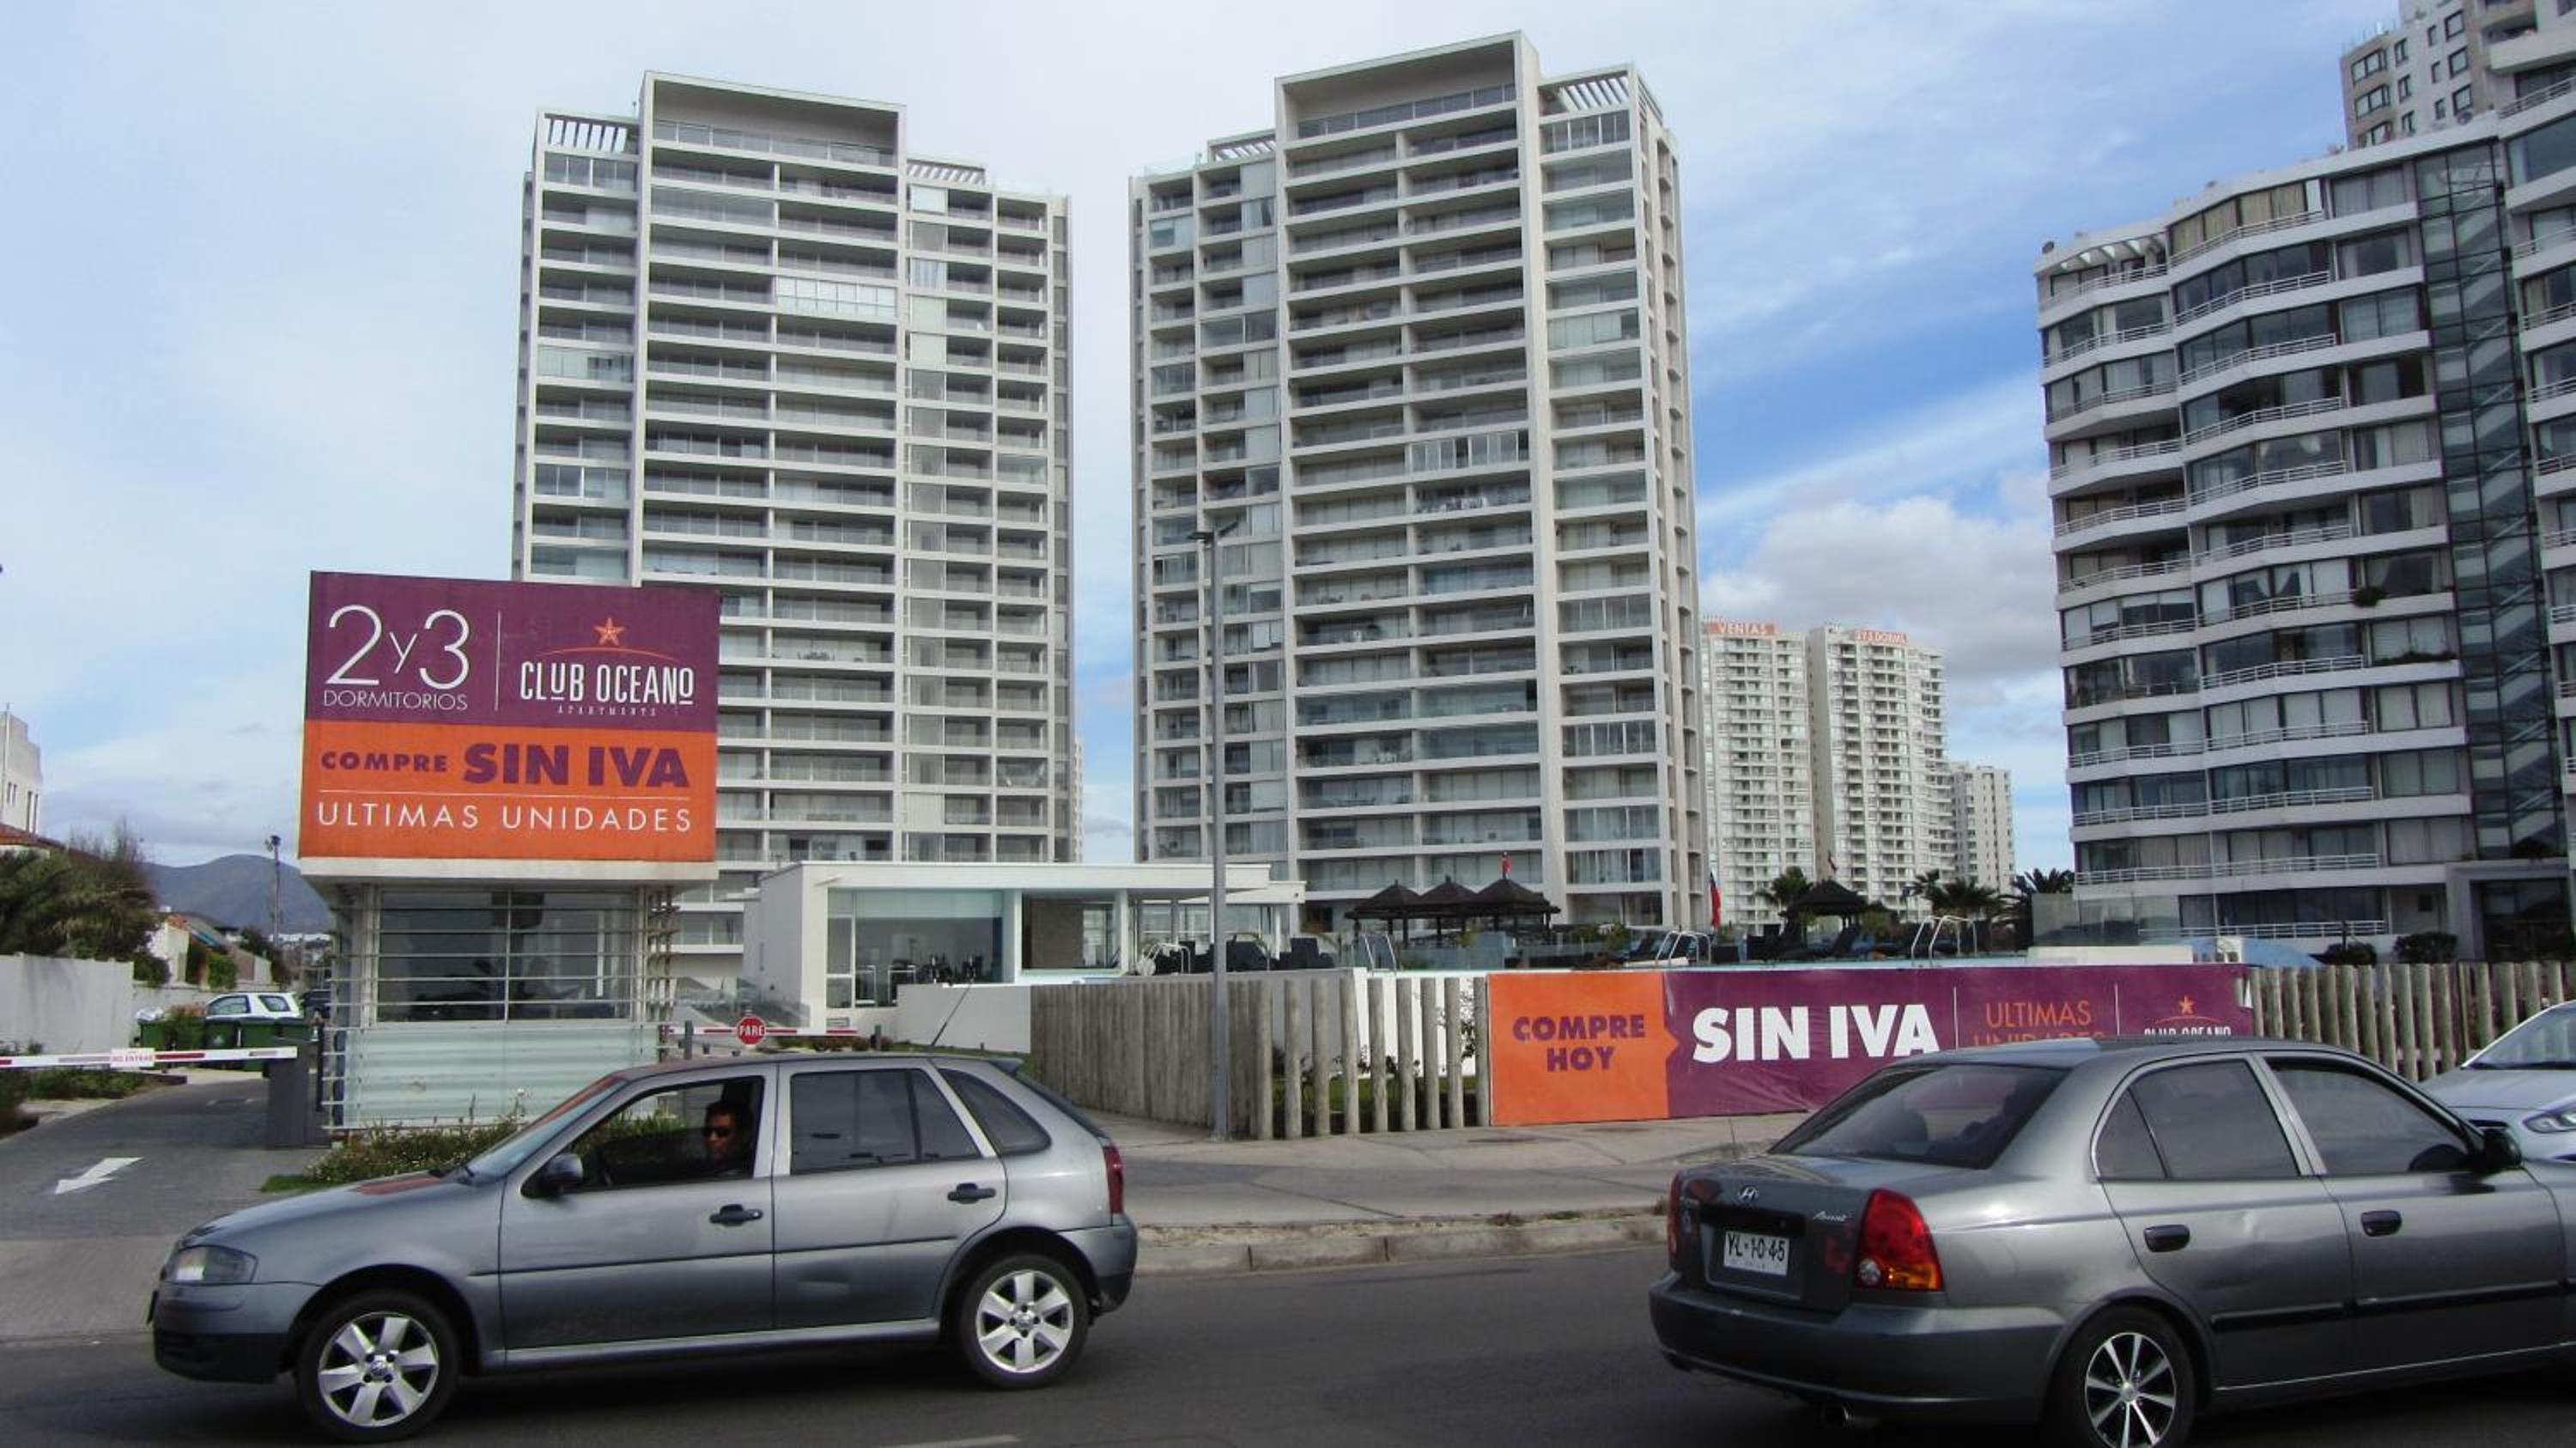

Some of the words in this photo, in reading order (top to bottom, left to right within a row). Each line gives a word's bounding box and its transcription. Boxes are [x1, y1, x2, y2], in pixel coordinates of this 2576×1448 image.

[519, 660, 585, 702] CLUB
[596, 664, 695, 705] OCEANO
[323, 690, 469, 711] DORMITORIOS
[320, 751, 448, 772] COMPRE
[463, 742, 570, 786] SIN
[588, 746, 691, 788] IVA
[318, 802, 480, 829] ULTIMAS
[501, 805, 692, 832] UNIDADES
[1512, 1014, 1646, 1041] COMPRE
[1985, 1001, 2092, 1028] ULTIMAS
[738, 1025, 764, 1037] PARE
[1692, 1007, 1811, 1063] SIN
[1829, 1004, 1941, 1059] IVA
[1547, 1047, 1615, 1072] HOY
